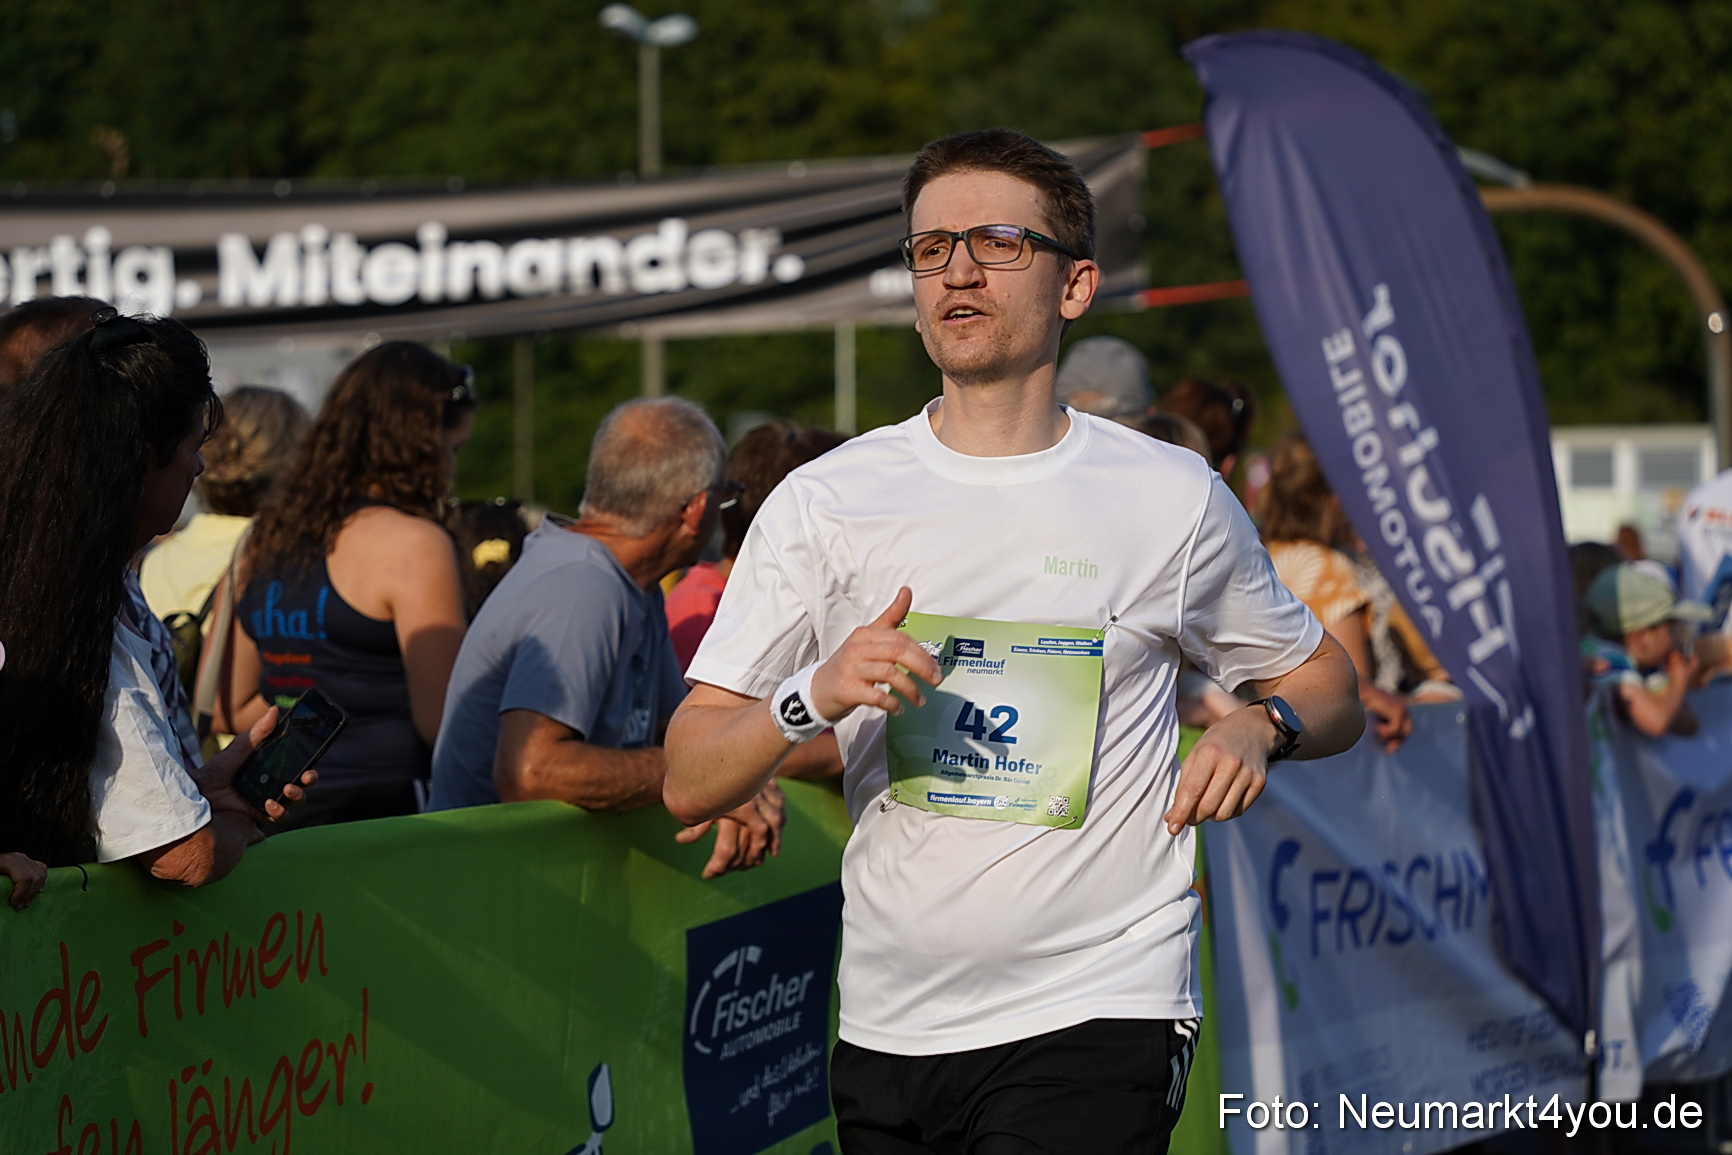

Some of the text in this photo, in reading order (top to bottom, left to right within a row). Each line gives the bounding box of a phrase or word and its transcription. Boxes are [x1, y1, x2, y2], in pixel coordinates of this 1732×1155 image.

[0, 218, 804, 323] rtig. Miteinander.
[1043, 555, 1099, 580] Martin
[943, 656, 1006, 669] Firmenlauf
[966, 667, 1004, 676] neumarkt
[954, 701, 1019, 745] 42
[932, 748, 1042, 775] Martin Hofer
[940, 769, 994, 781] Allgemeinarztpraxis
[929, 794, 992, 806] firmenlauf.bayern
[130, 909, 329, 1038] Firmen
[711, 970, 815, 1039] Fischer
[719, 1010, 801, 1061] AUTOMOBILE
